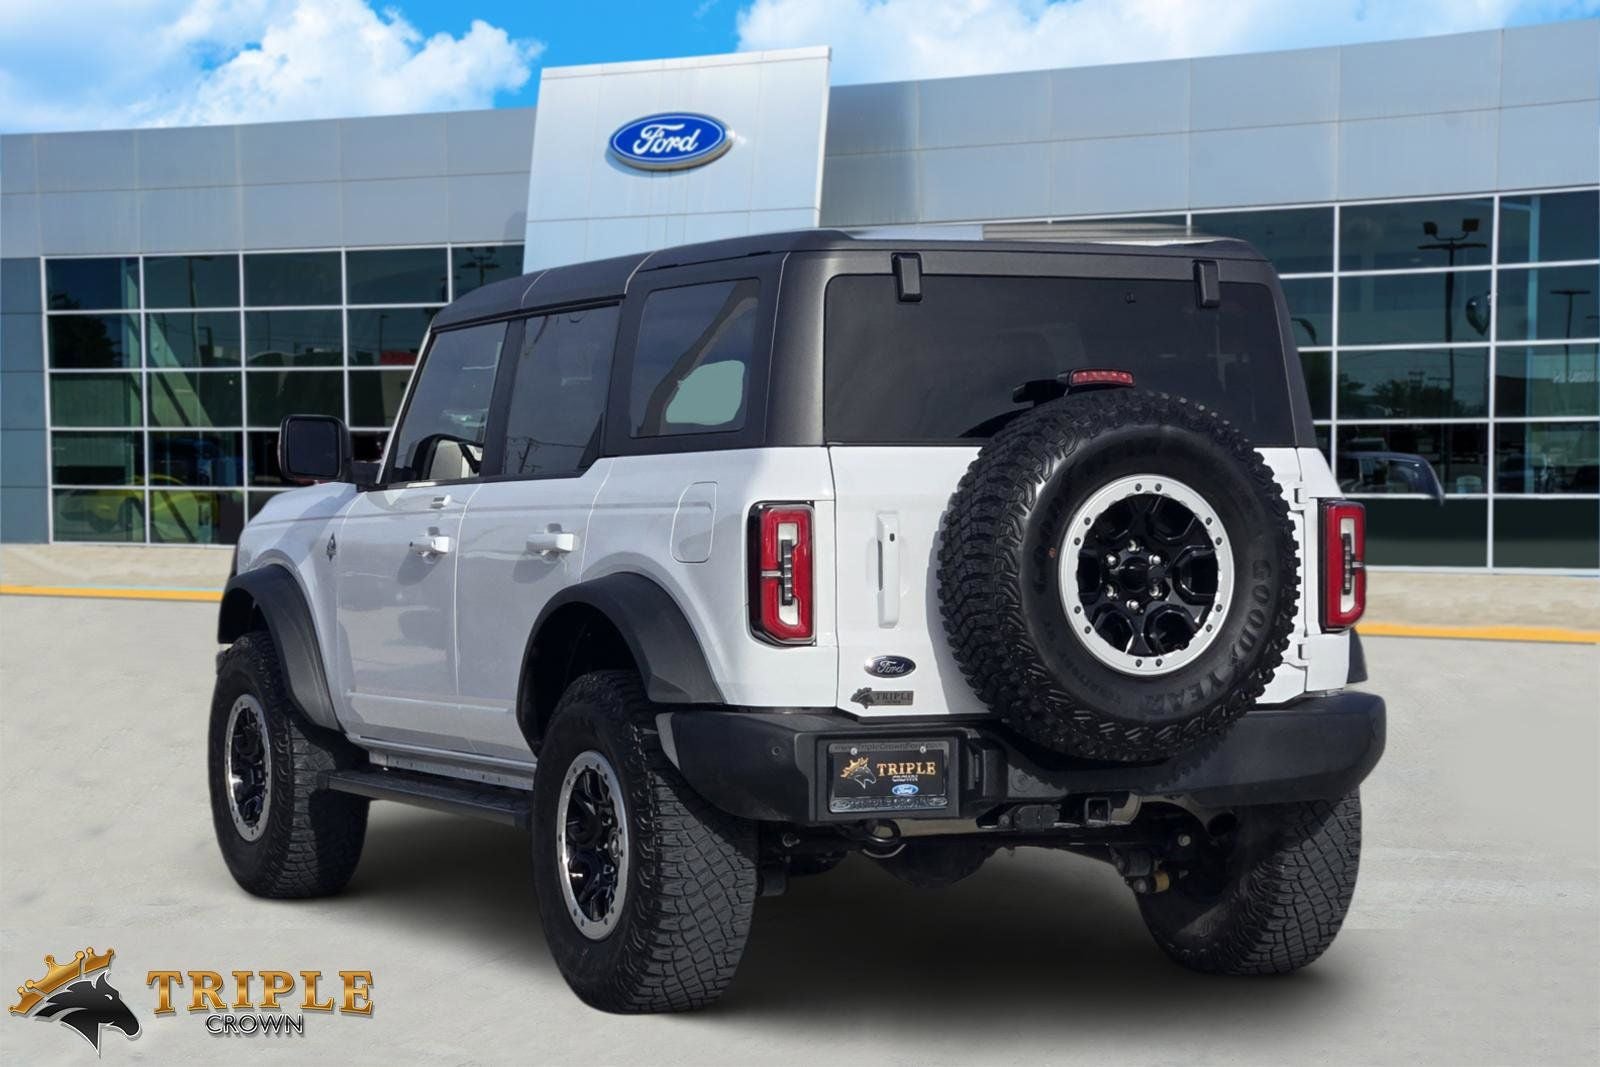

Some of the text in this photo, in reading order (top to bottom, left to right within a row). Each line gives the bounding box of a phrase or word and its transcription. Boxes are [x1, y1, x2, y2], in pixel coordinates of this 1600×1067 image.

[632, 123, 702, 155] Ford
[877, 660, 905, 674] Ford
[876, 761, 937, 777] TRIPLE
